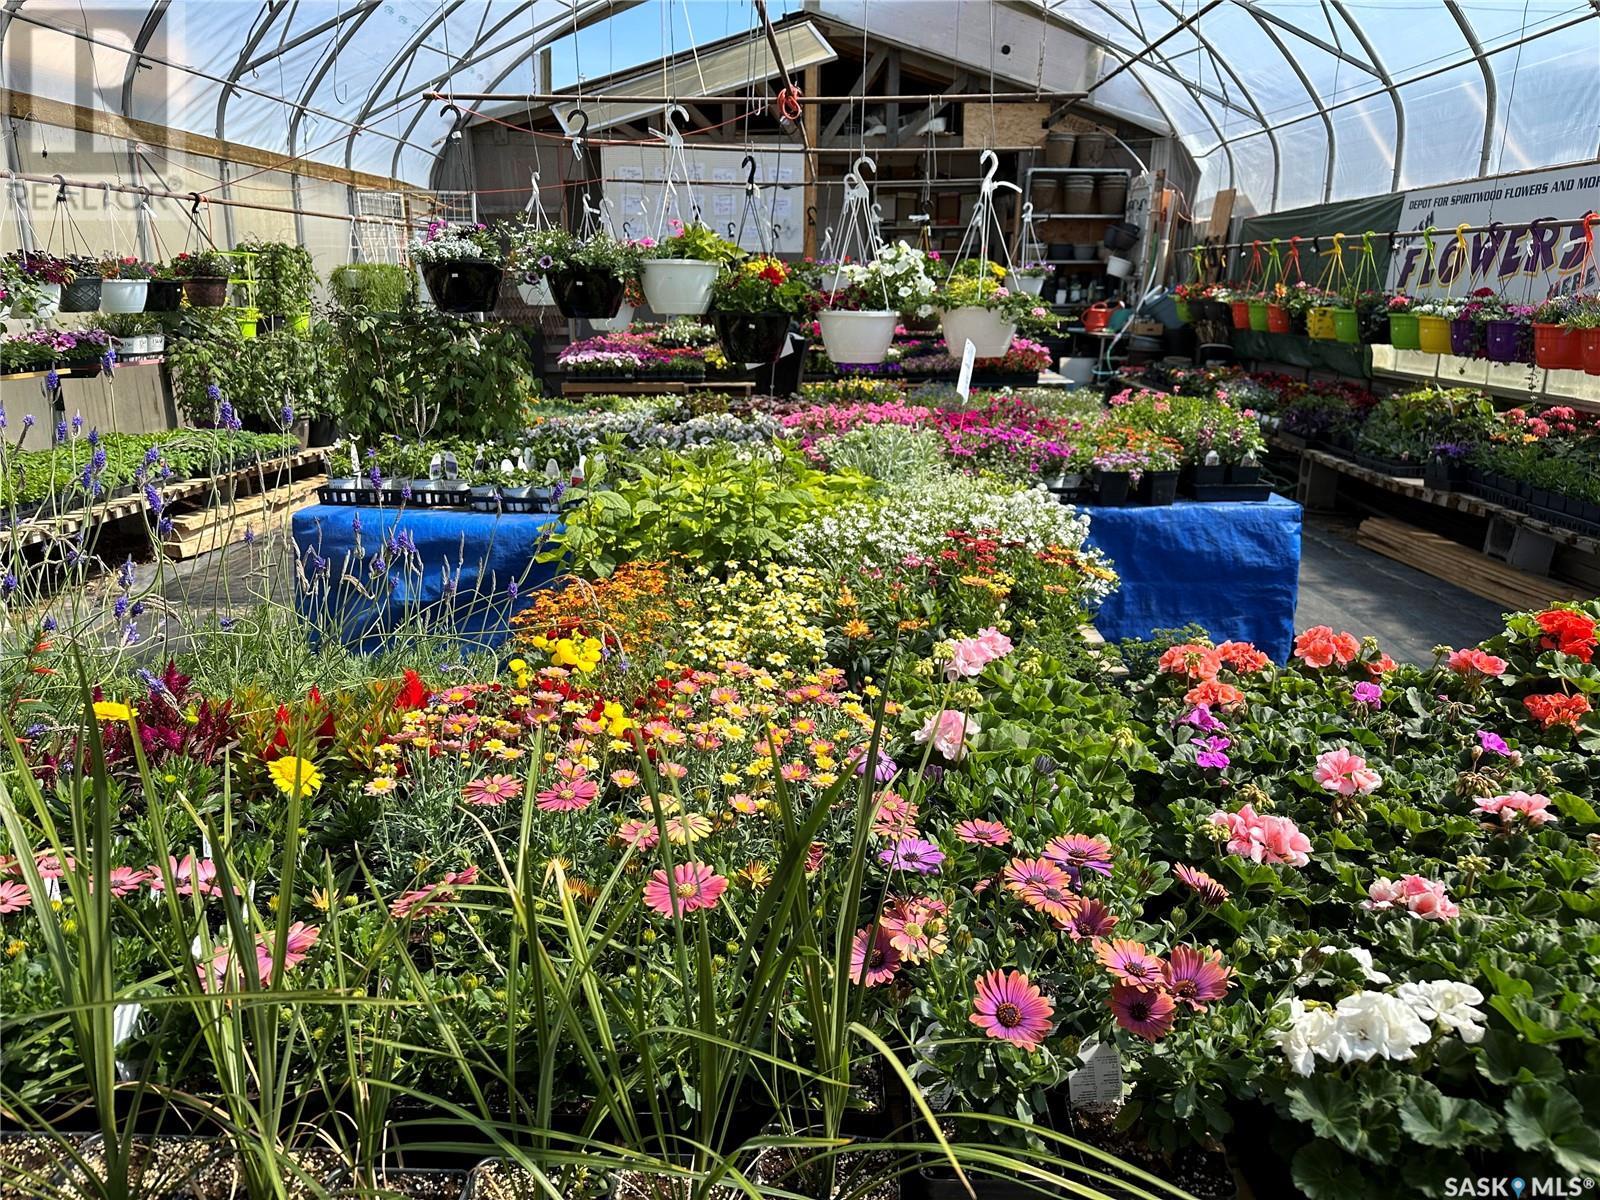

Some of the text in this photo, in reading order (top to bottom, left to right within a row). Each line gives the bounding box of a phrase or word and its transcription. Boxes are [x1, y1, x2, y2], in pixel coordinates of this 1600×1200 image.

[1408, 198, 1432, 210] DEPOT
[1433, 196, 1449, 207] FOR
[1450, 189, 1502, 206] SPIRITWOOD
[1504, 183, 1548, 199] FLOWERS
[1551, 178, 1575, 193] AND
[1397, 210, 1595, 289] FLOWERS
